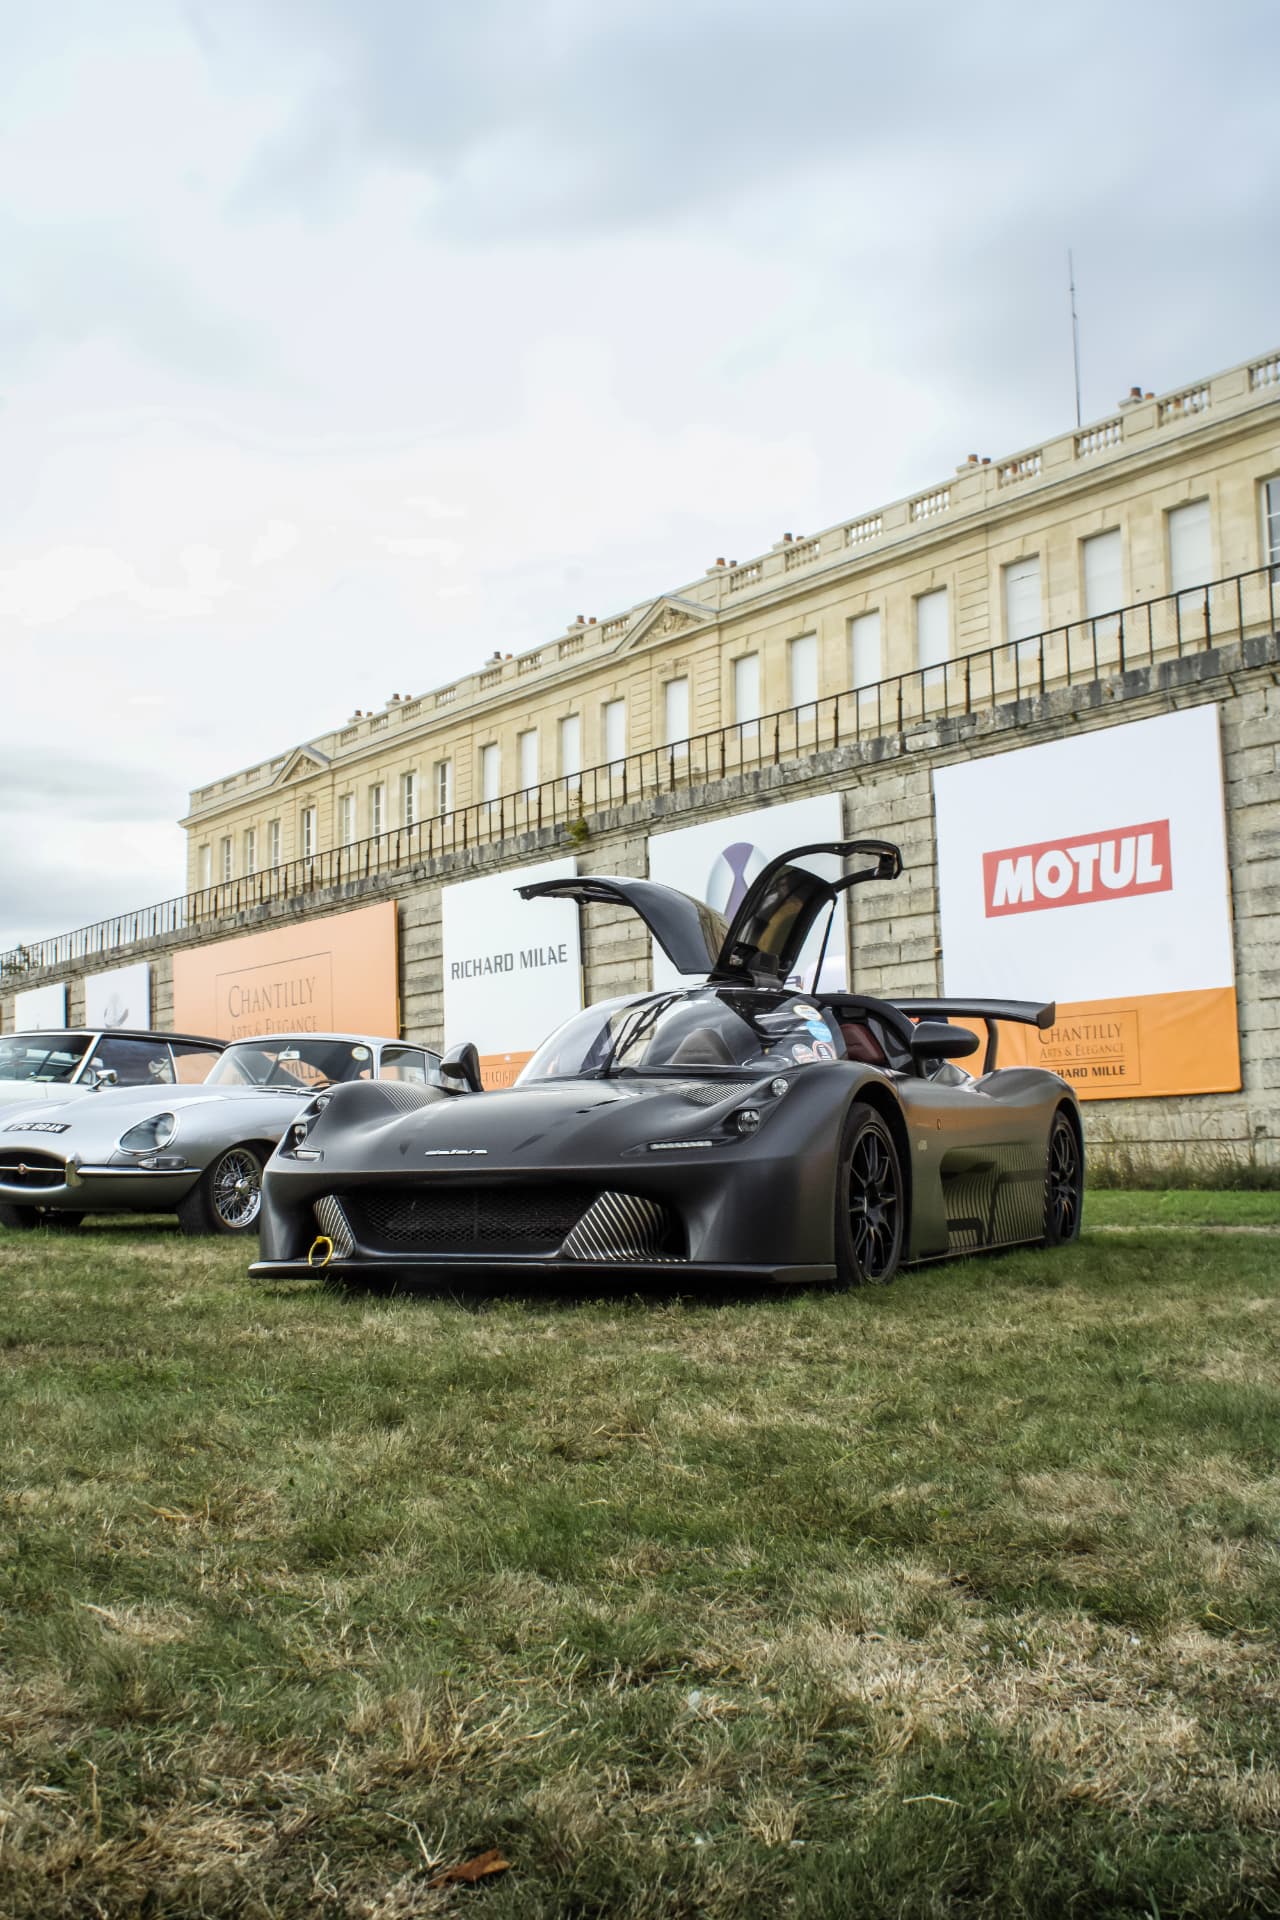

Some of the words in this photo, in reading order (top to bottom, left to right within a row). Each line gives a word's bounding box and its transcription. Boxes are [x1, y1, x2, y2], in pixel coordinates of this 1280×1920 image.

[992, 833, 1162, 907] MOTUL
[451, 953, 513, 980] RICHARD
[520, 944, 567, 969] MILAE
[1091, 1065, 1125, 1077] MILLE
